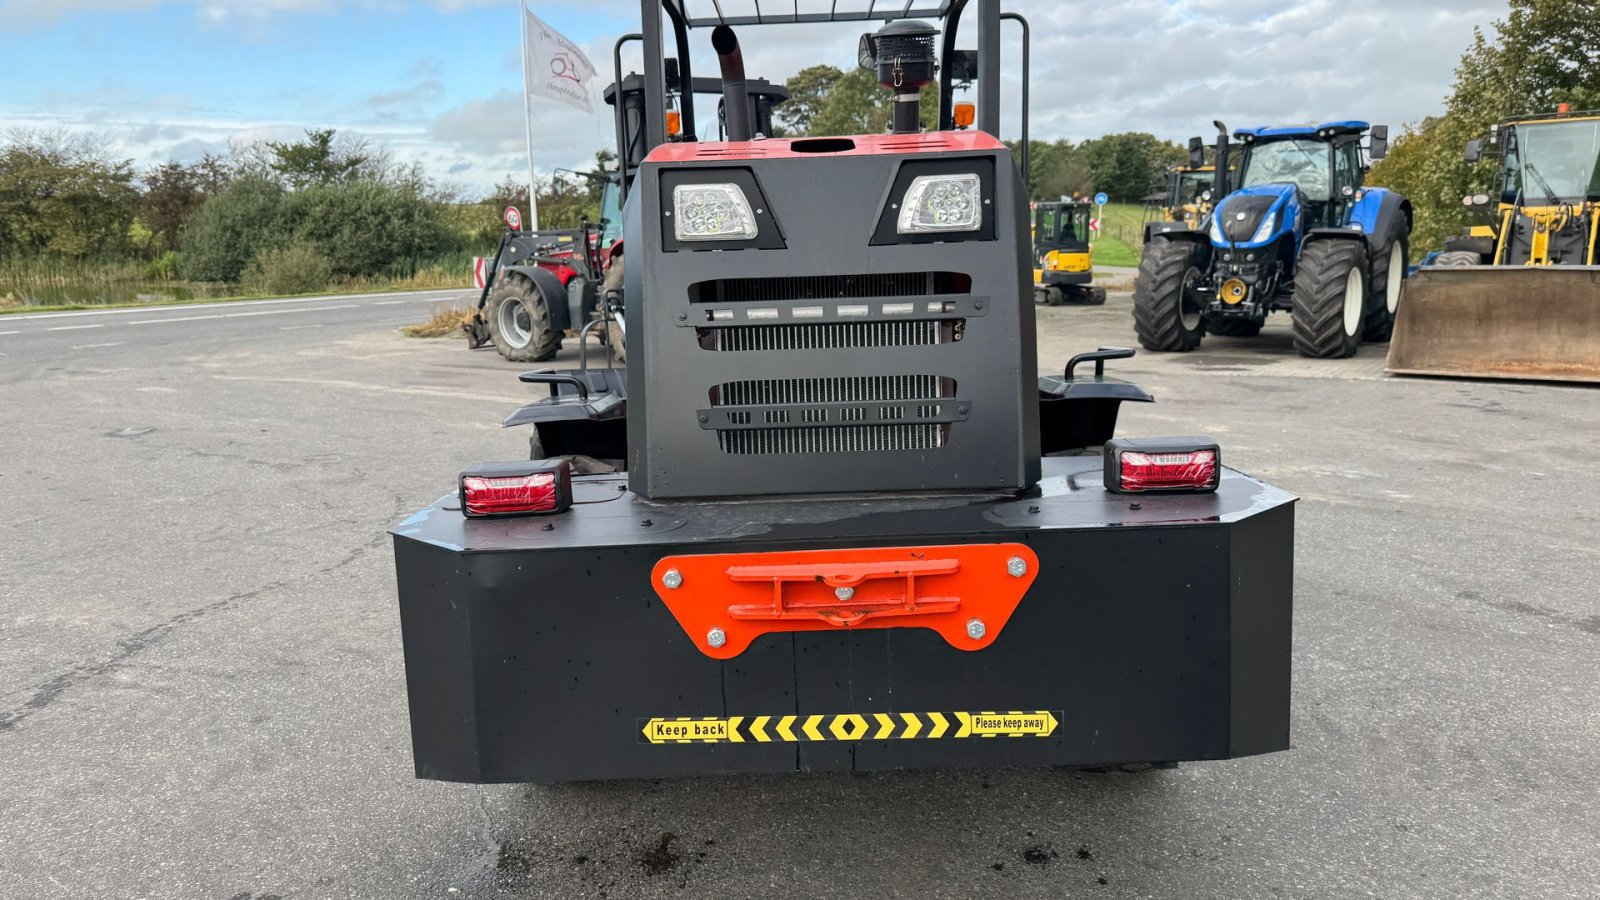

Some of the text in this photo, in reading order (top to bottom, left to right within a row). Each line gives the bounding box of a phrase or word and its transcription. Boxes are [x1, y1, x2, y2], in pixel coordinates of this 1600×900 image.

[656, 723, 725, 738] Keep back
[975, 716, 1044, 731] Please keep away
